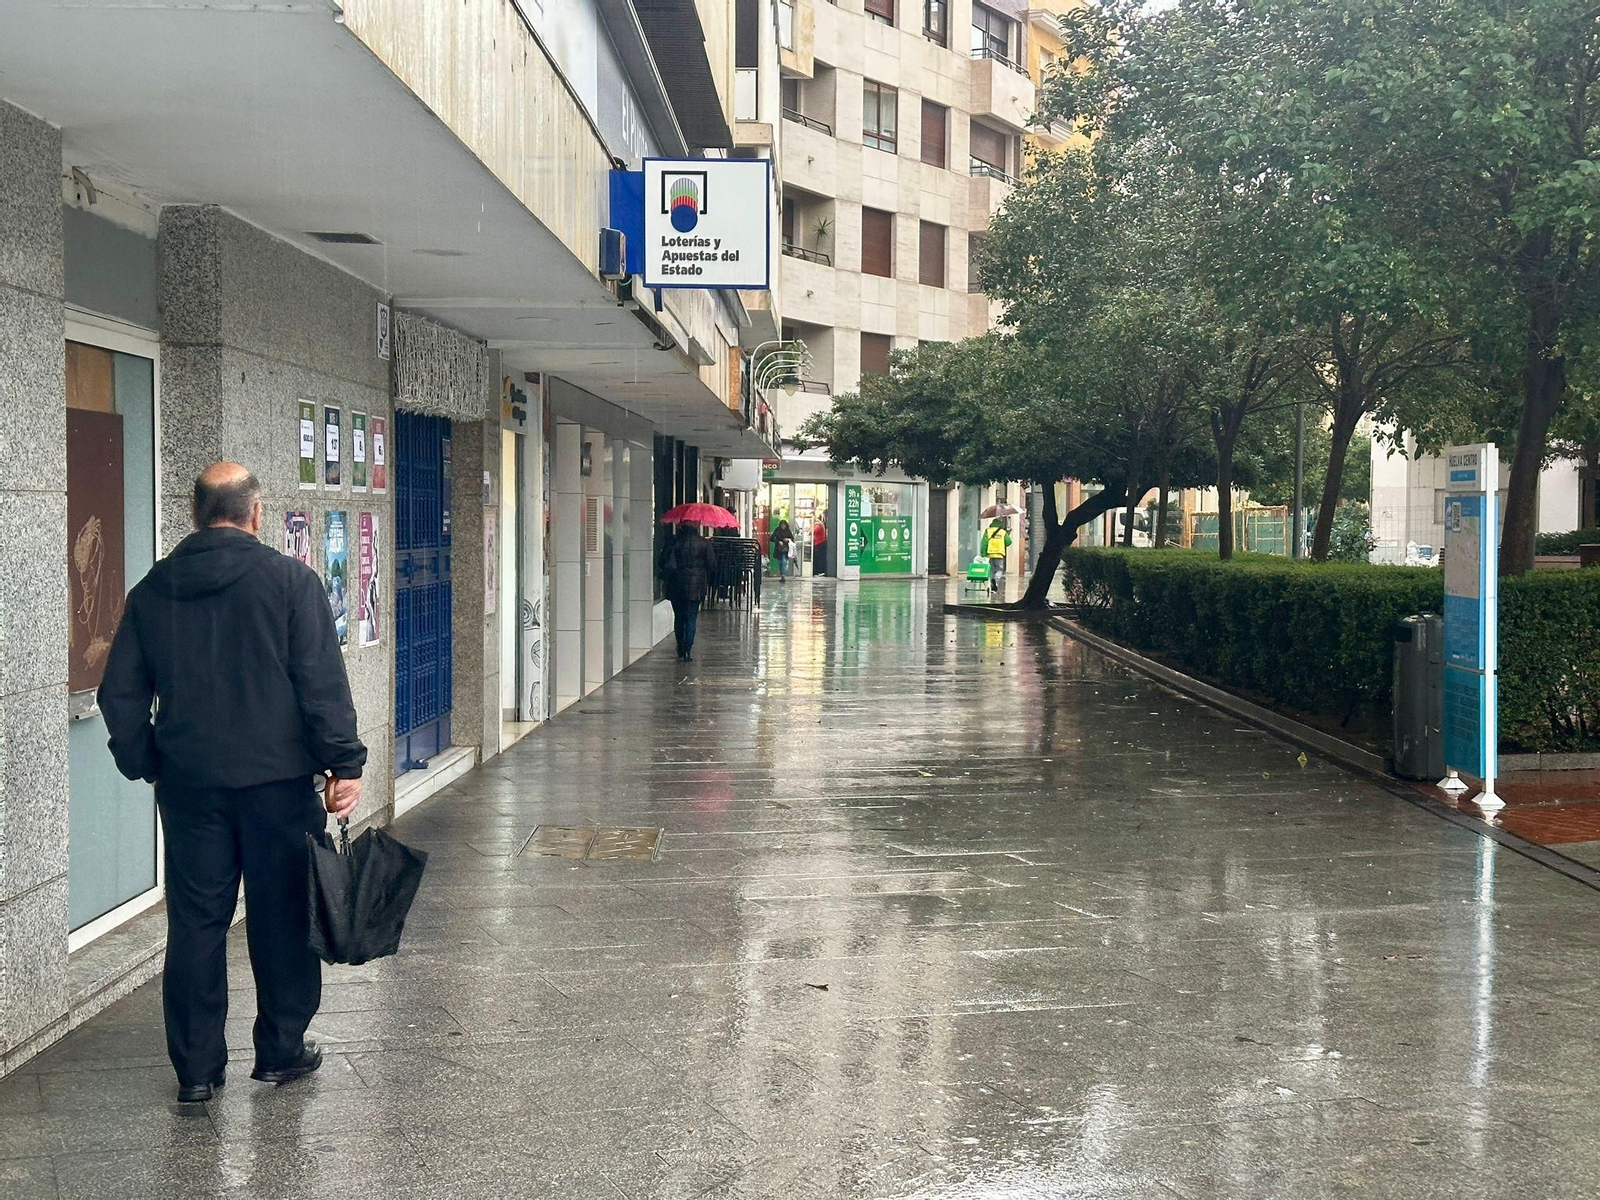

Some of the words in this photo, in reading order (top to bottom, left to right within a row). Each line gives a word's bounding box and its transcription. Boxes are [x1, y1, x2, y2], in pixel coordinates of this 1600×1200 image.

[661, 236, 710, 247] Loterías
[714, 238, 721, 250] y
[661, 250, 718, 263] Apuestas
[721, 250, 739, 261] del
[661, 264, 703, 275] Estado
